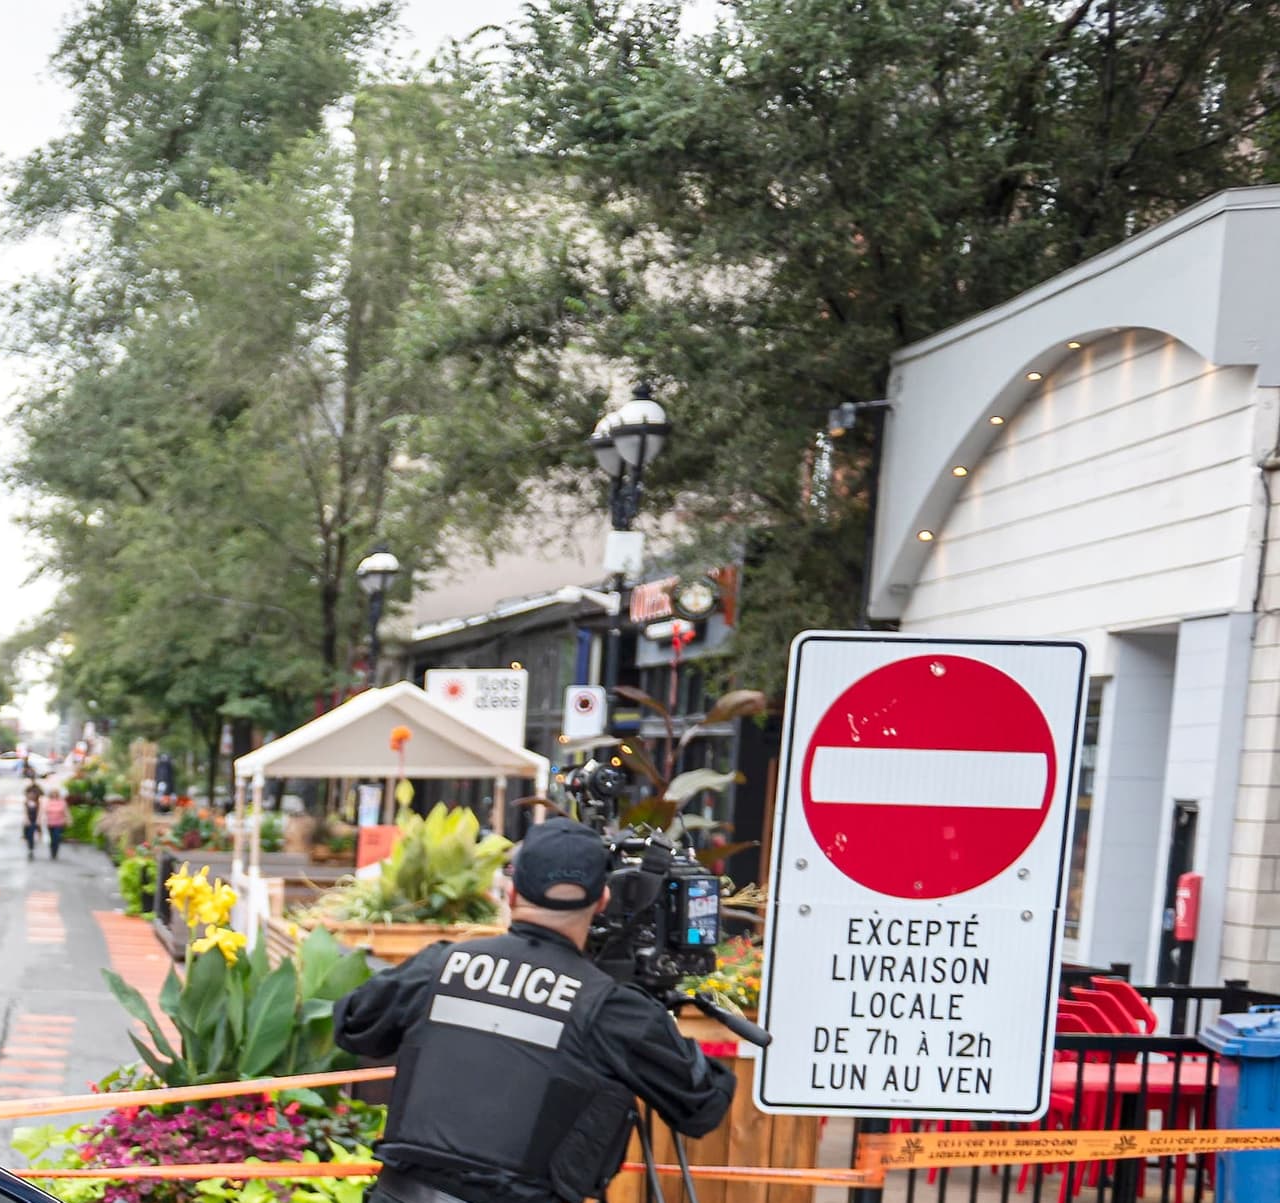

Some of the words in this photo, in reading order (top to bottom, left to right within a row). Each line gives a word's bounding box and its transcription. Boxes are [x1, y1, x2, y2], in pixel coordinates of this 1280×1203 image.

[847, 913, 980, 948] EXCEPTÉ
[439, 951, 583, 1012] POLICE
[832, 954, 989, 985] LIVRAISON
[851, 991, 964, 1021] LOCALE
[814, 1027, 849, 1055] DE
[867, 1028, 898, 1056] 7h
[916, 1031, 930, 1057] À
[948, 1031, 992, 1058] 12h
[811, 1063, 867, 1092] LUN
[882, 1065, 921, 1093] AU
[938, 1066, 993, 1095] VEN
